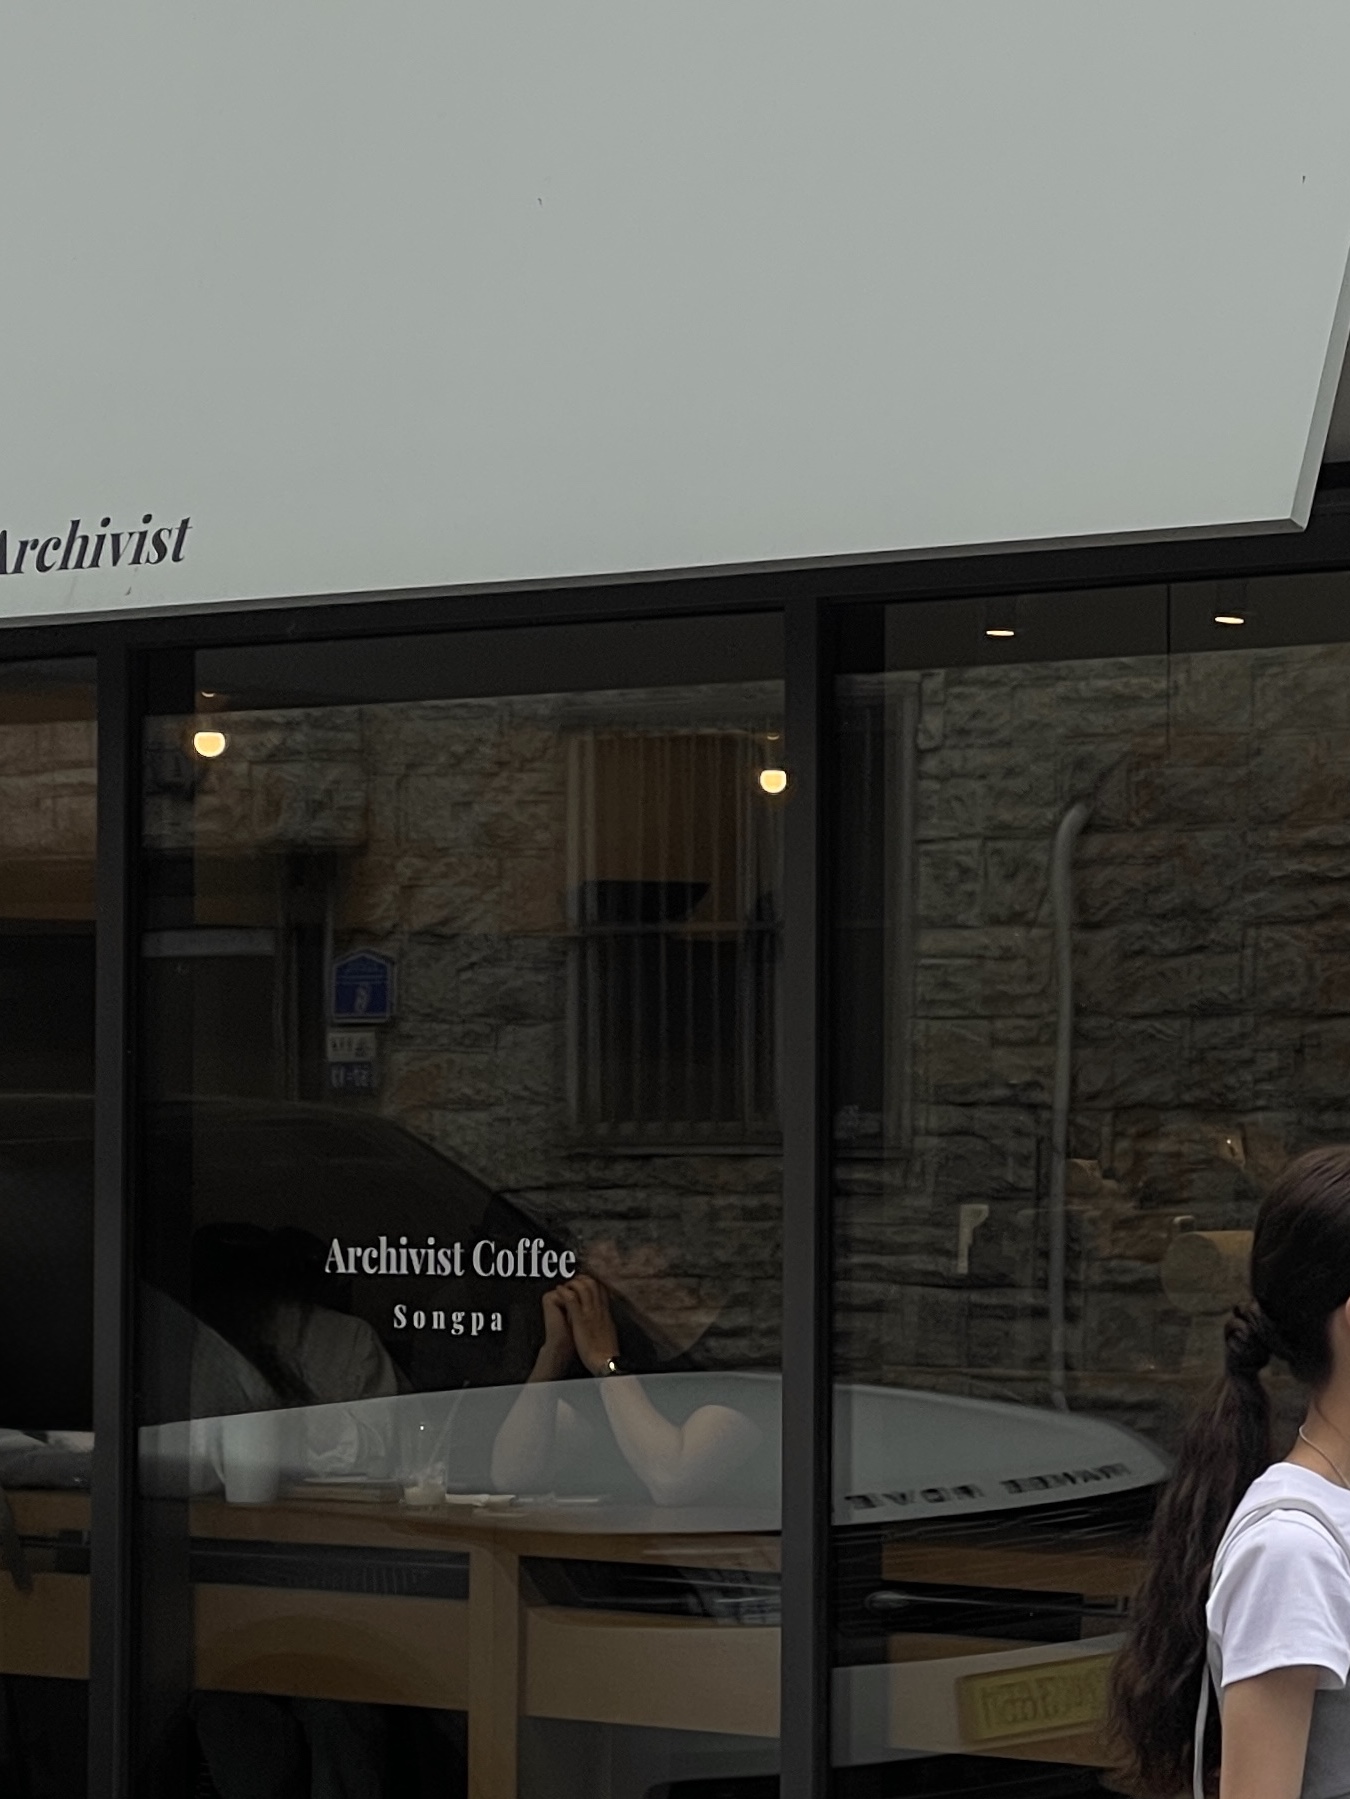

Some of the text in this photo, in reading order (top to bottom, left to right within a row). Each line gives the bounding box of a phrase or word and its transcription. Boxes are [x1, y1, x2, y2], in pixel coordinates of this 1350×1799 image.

[325, 1235, 576, 1278] Archivist Coffee
[393, 1304, 503, 1336] Songpa
